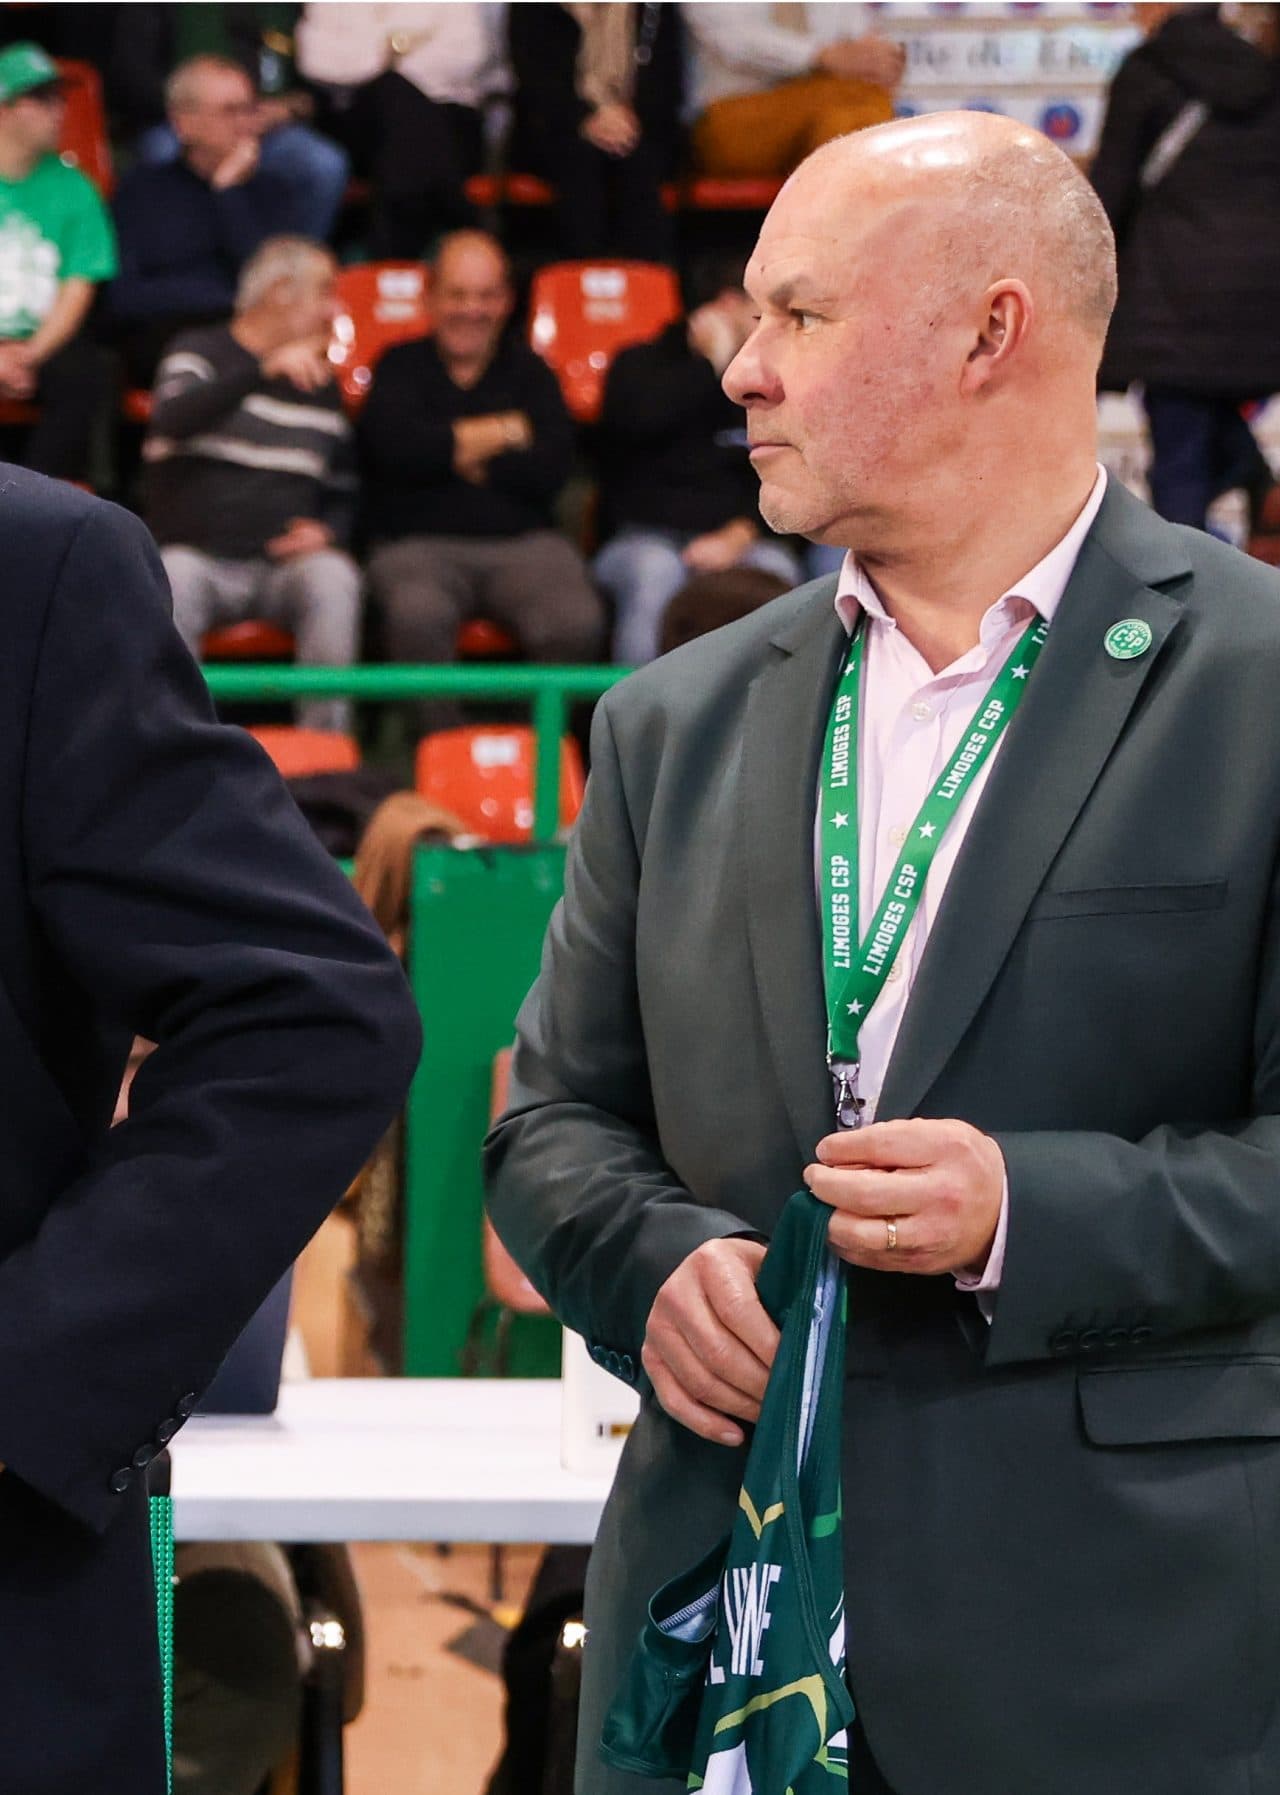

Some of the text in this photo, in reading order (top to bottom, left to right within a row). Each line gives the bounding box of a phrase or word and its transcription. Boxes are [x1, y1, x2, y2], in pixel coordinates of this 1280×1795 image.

[830, 694, 852, 788] LIMOGES CSP
[937, 699, 1005, 799] LIMOGES CSP
[831, 855, 850, 969] LIMOGES CSP
[862, 863, 918, 976] LIMOGES CSP
